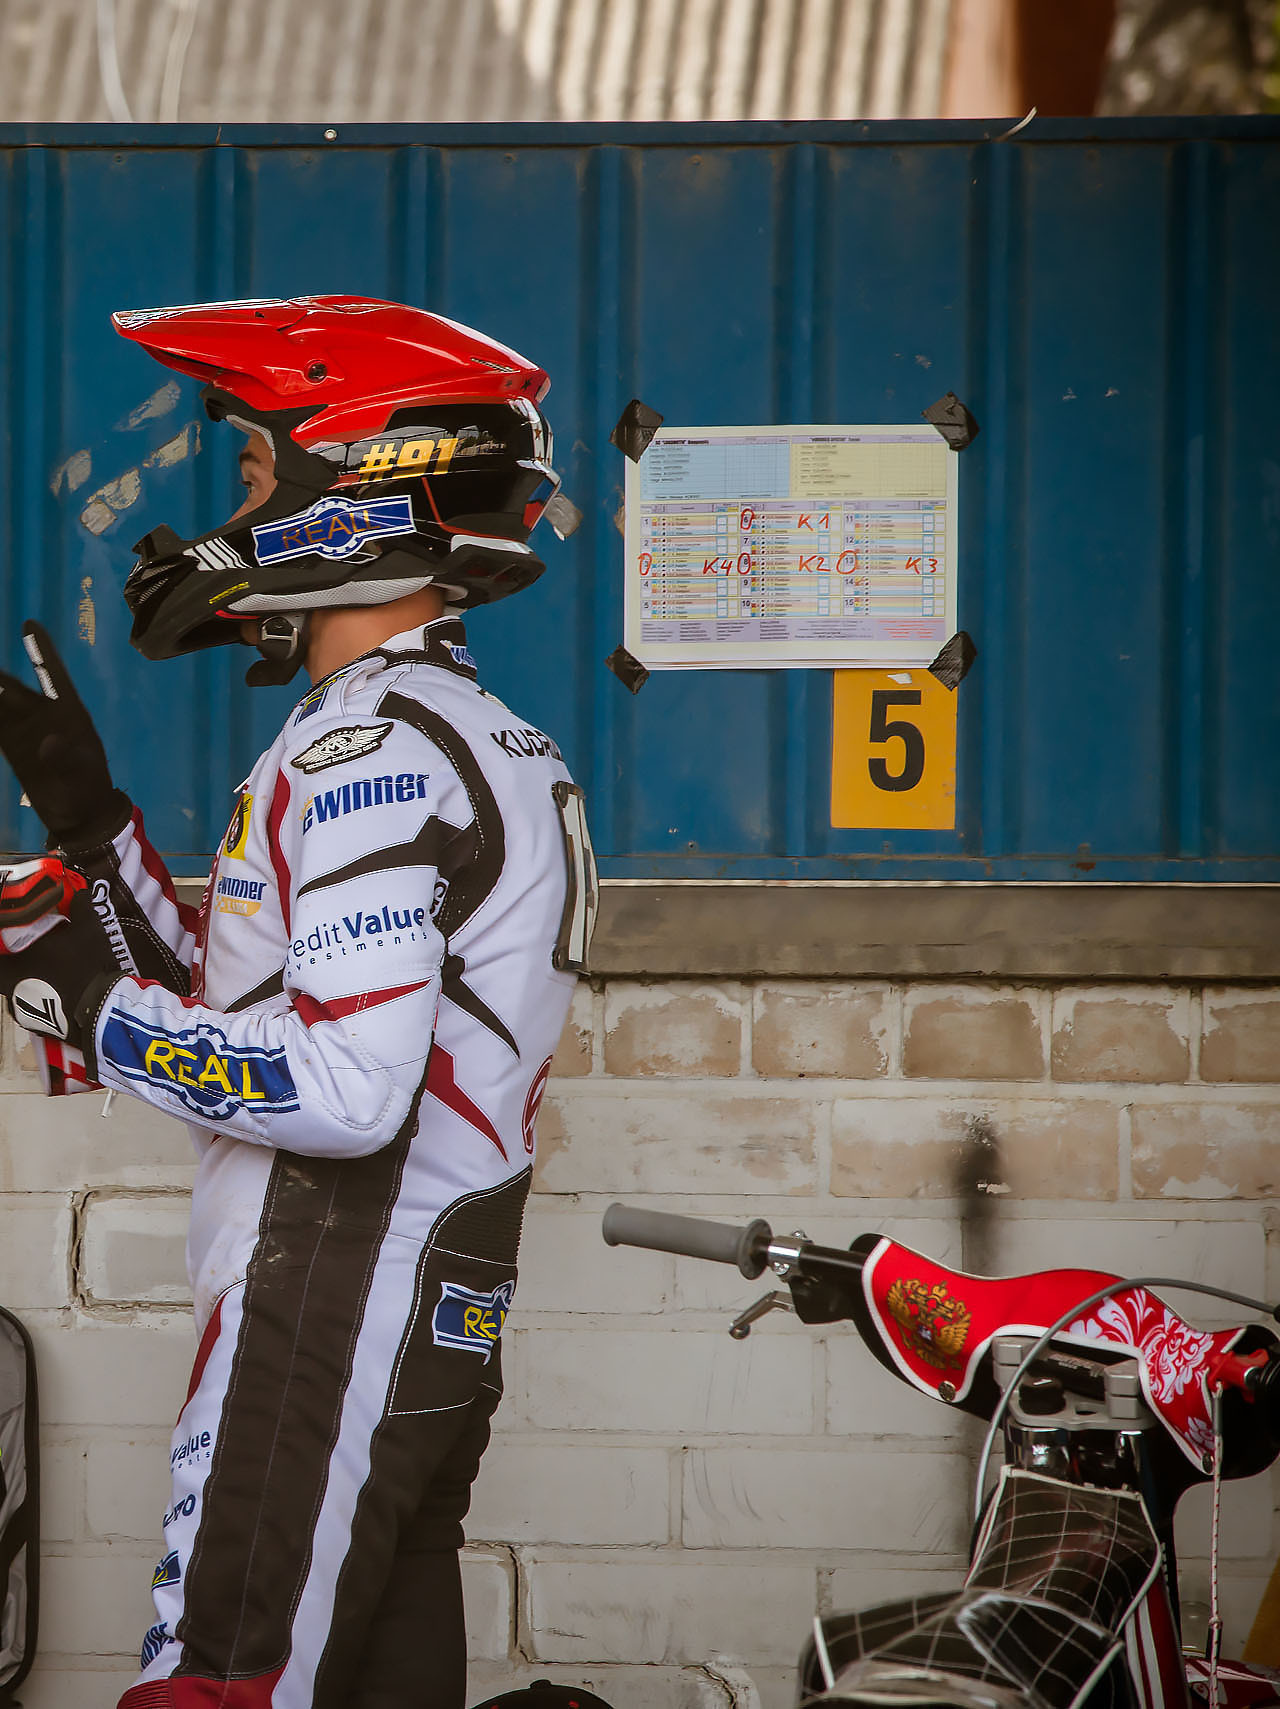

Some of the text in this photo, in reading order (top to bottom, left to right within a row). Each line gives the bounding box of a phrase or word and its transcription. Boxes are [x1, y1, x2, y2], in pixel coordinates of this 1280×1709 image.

[358, 437, 459, 483] #91
[281, 509, 383, 551] REALL
[868, 689, 926, 793] 5
